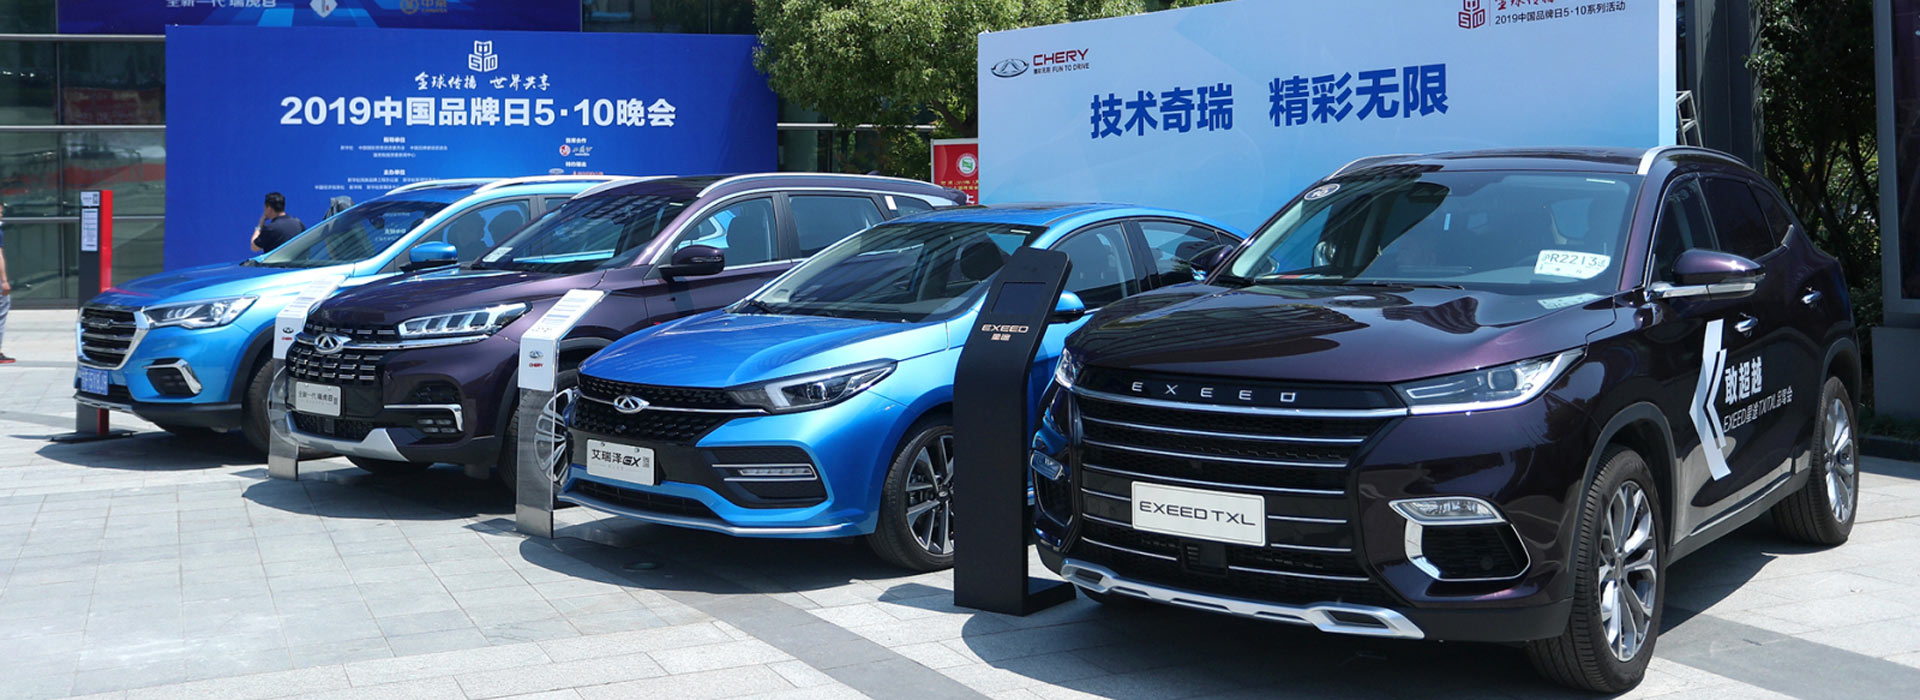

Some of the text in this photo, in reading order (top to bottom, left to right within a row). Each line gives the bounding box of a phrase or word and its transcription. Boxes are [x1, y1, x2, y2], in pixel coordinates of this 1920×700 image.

[1033, 48, 1089, 66] CHERY
[1052, 65, 1064, 73] FUN
[1065, 64, 1072, 72] TO
[1073, 62, 1090, 71] DRIVE
[415, 71, 551, 91] 全球传播 世界共享
[280, 96, 677, 127] 2019中国品牌日5·10晚会
[1091, 63, 1450, 139] 技术奇瑞 精彩无限
[981, 323, 1030, 334] EXEED
[1131, 381, 1297, 402] EXEED
[1724, 356, 1763, 406] 敢超越
[1139, 500, 1256, 526] EXEED TXL
